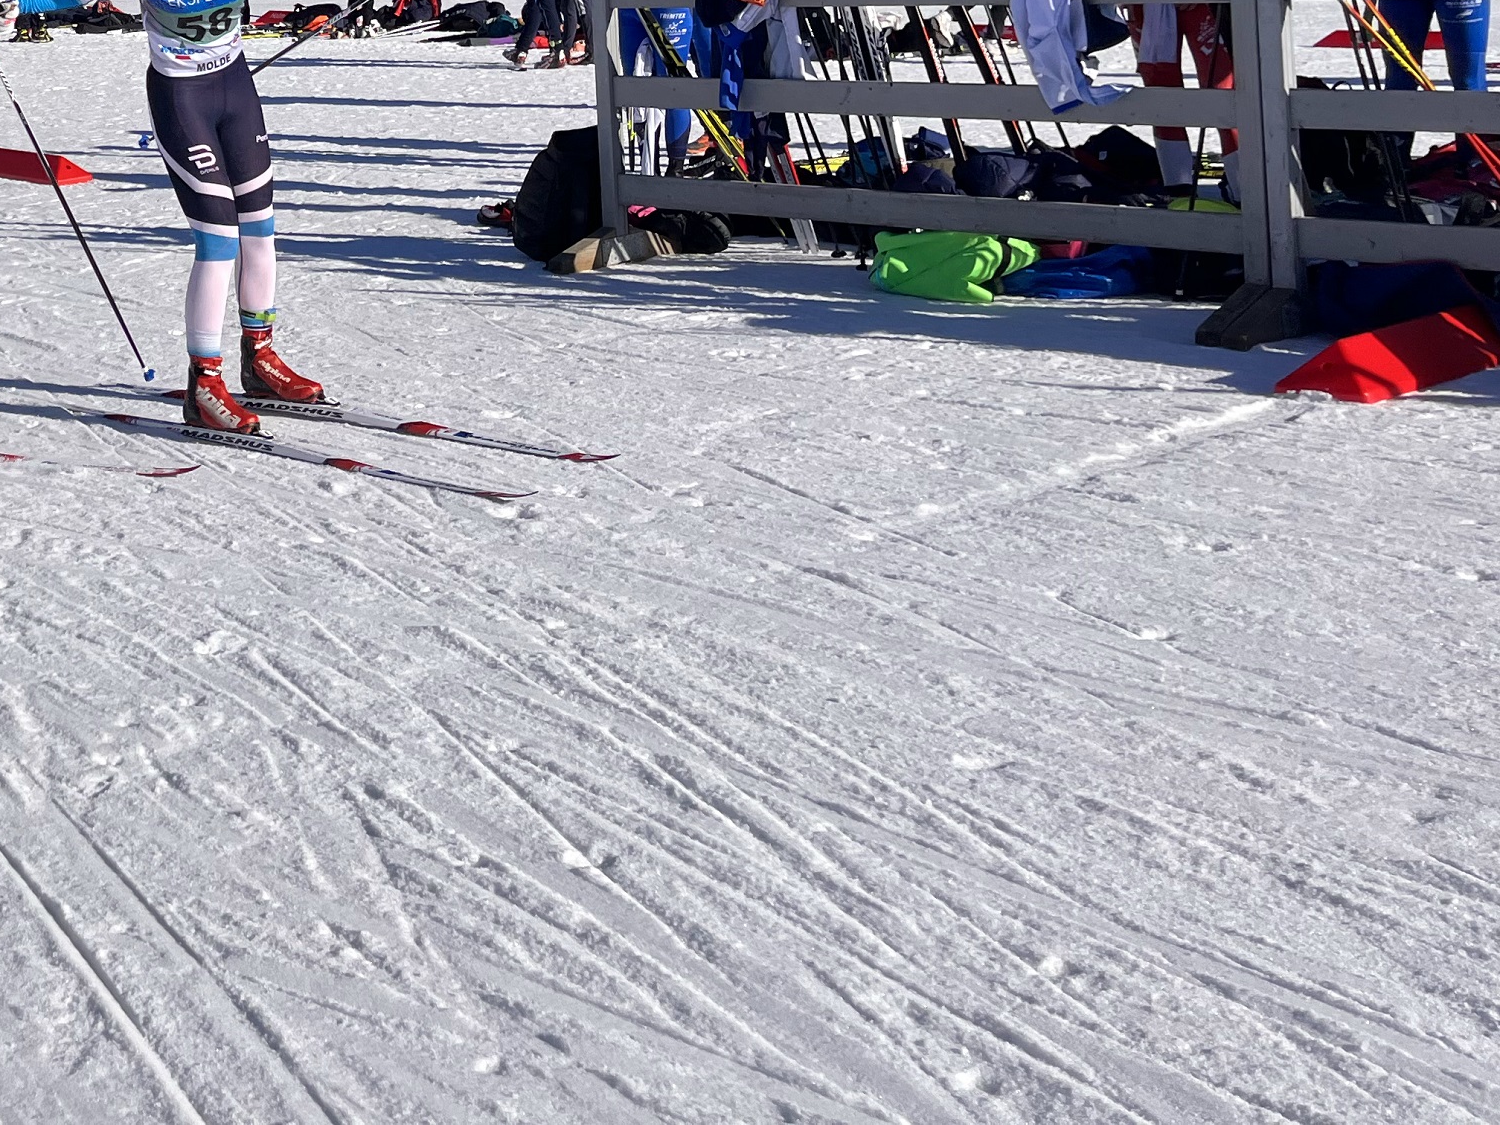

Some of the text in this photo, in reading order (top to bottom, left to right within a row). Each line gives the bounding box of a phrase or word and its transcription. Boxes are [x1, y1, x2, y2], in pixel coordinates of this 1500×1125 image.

[177, 7, 233, 42] 58
[196, 53, 232, 72] MOLDE
[258, 359, 292, 384] alpina
[243, 400, 345, 419] MADSHUS
[180, 428, 275, 452] MADSHUS
